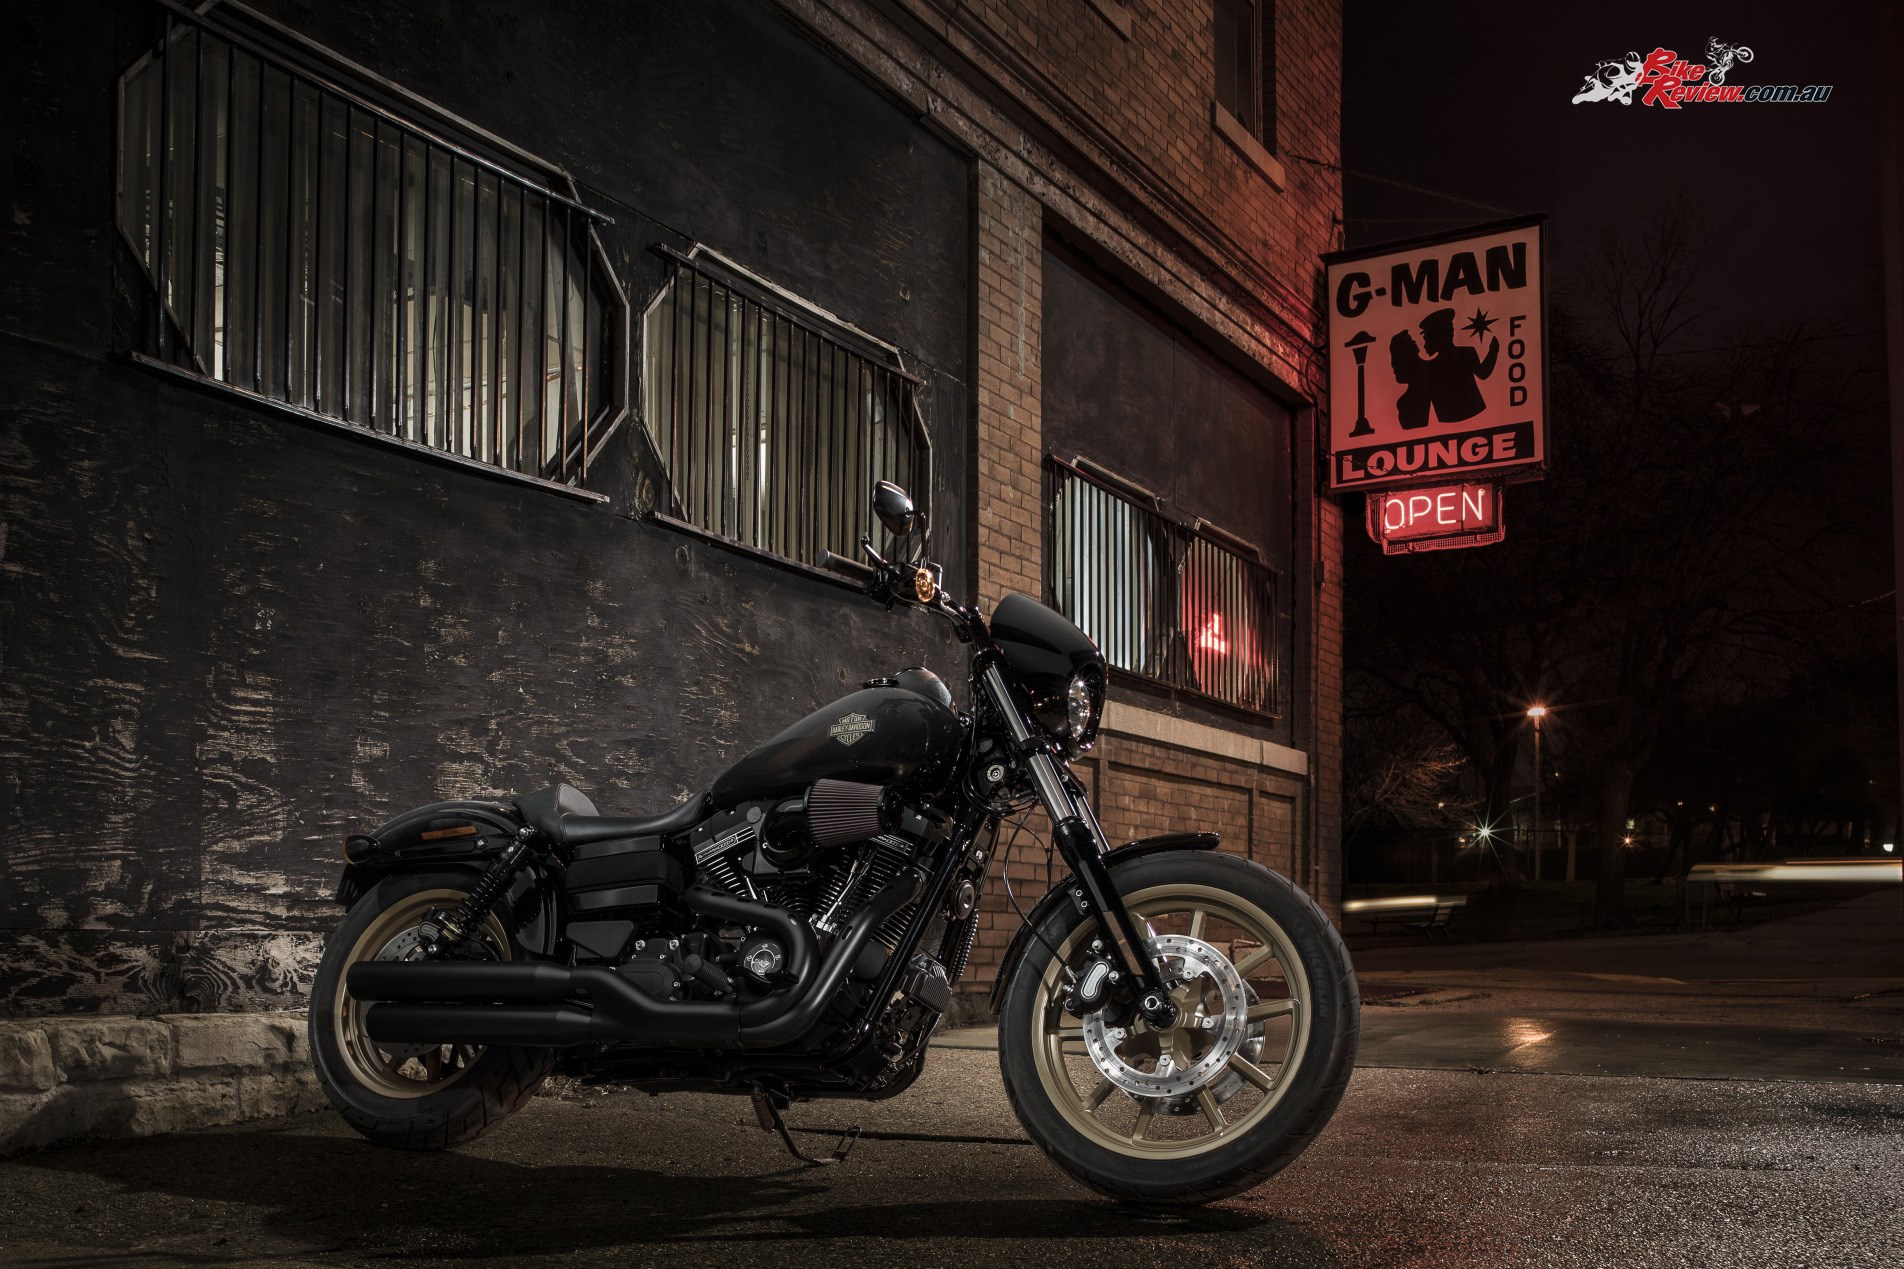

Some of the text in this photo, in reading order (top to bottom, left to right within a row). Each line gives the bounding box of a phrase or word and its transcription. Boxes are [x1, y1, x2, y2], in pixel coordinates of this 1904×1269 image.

[1336, 242, 1527, 318] G-MAN
[1507, 314, 1527, 407] FOOD
[1342, 432, 1517, 481] LOUNGE
[1384, 488, 1485, 531] OPEN
